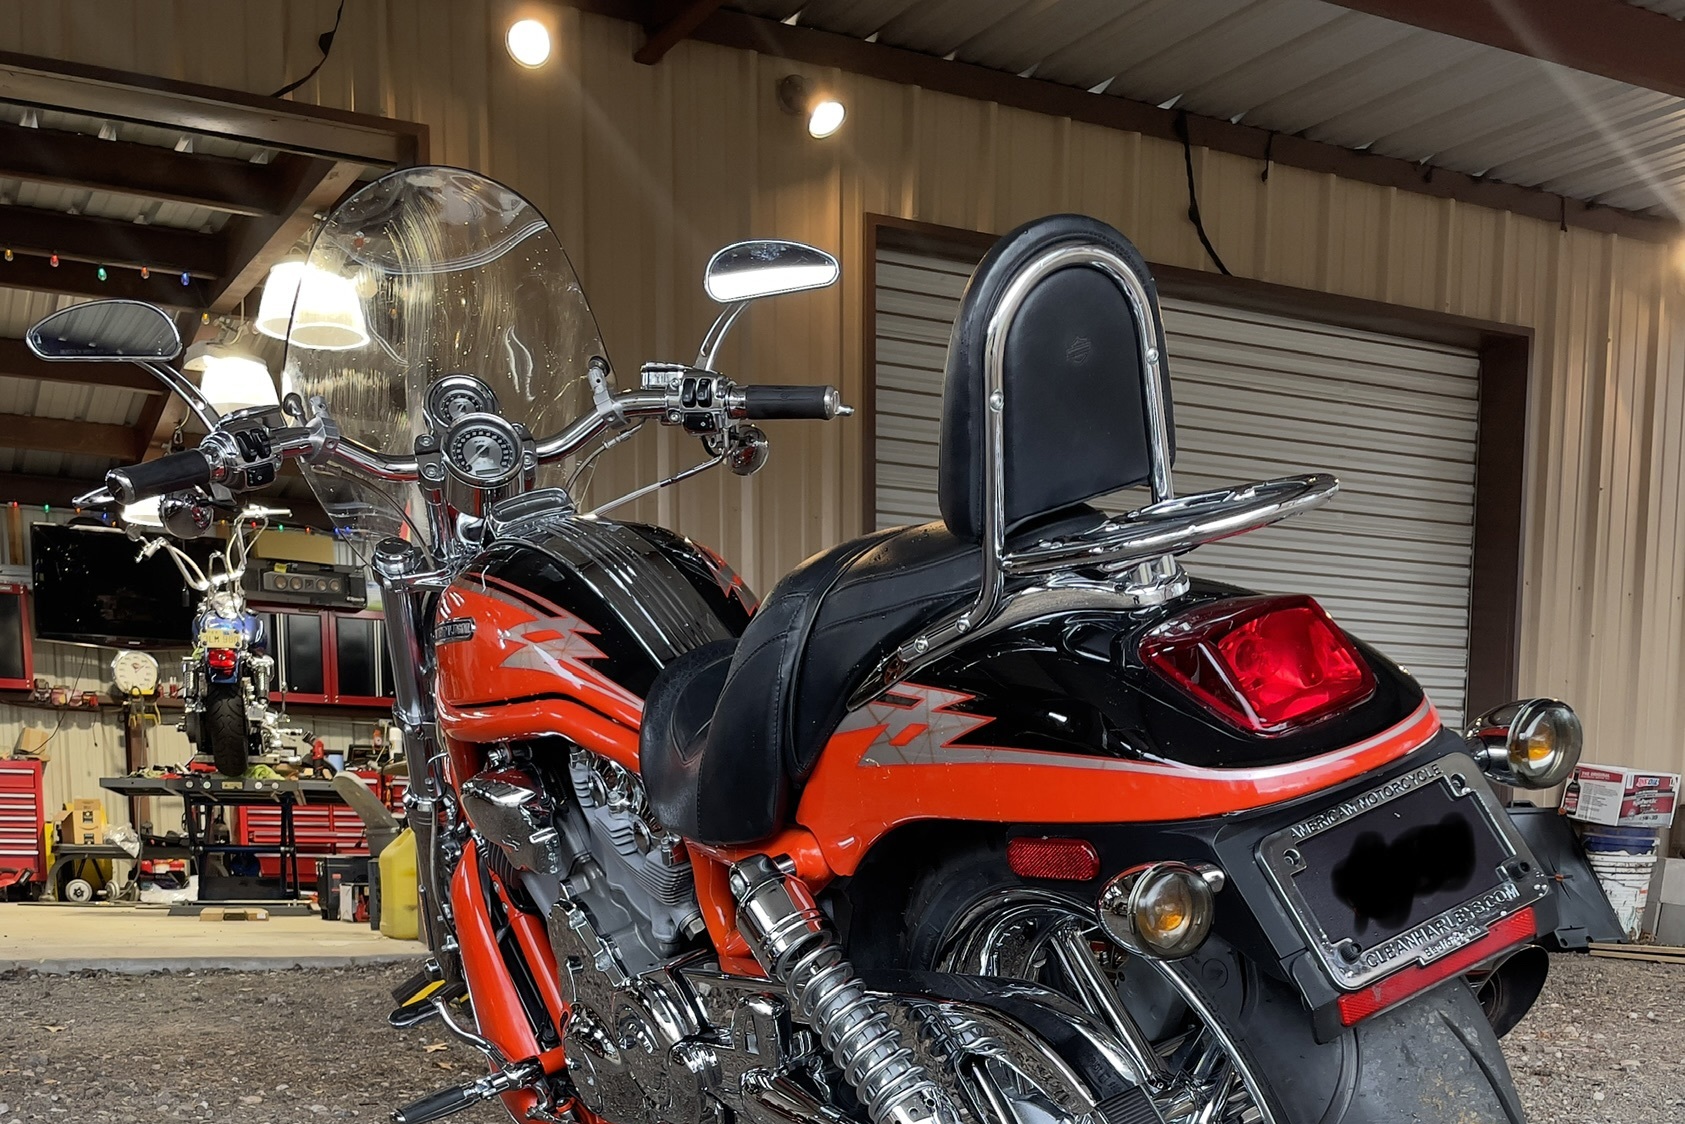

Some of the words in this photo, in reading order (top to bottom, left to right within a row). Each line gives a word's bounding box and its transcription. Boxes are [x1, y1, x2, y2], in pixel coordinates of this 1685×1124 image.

[1291, 803, 1358, 840] AMERICAN
[1358, 763, 1443, 810] MOTORCYCLE
[1366, 883, 1520, 967] CLEANHARLEYS.COM
